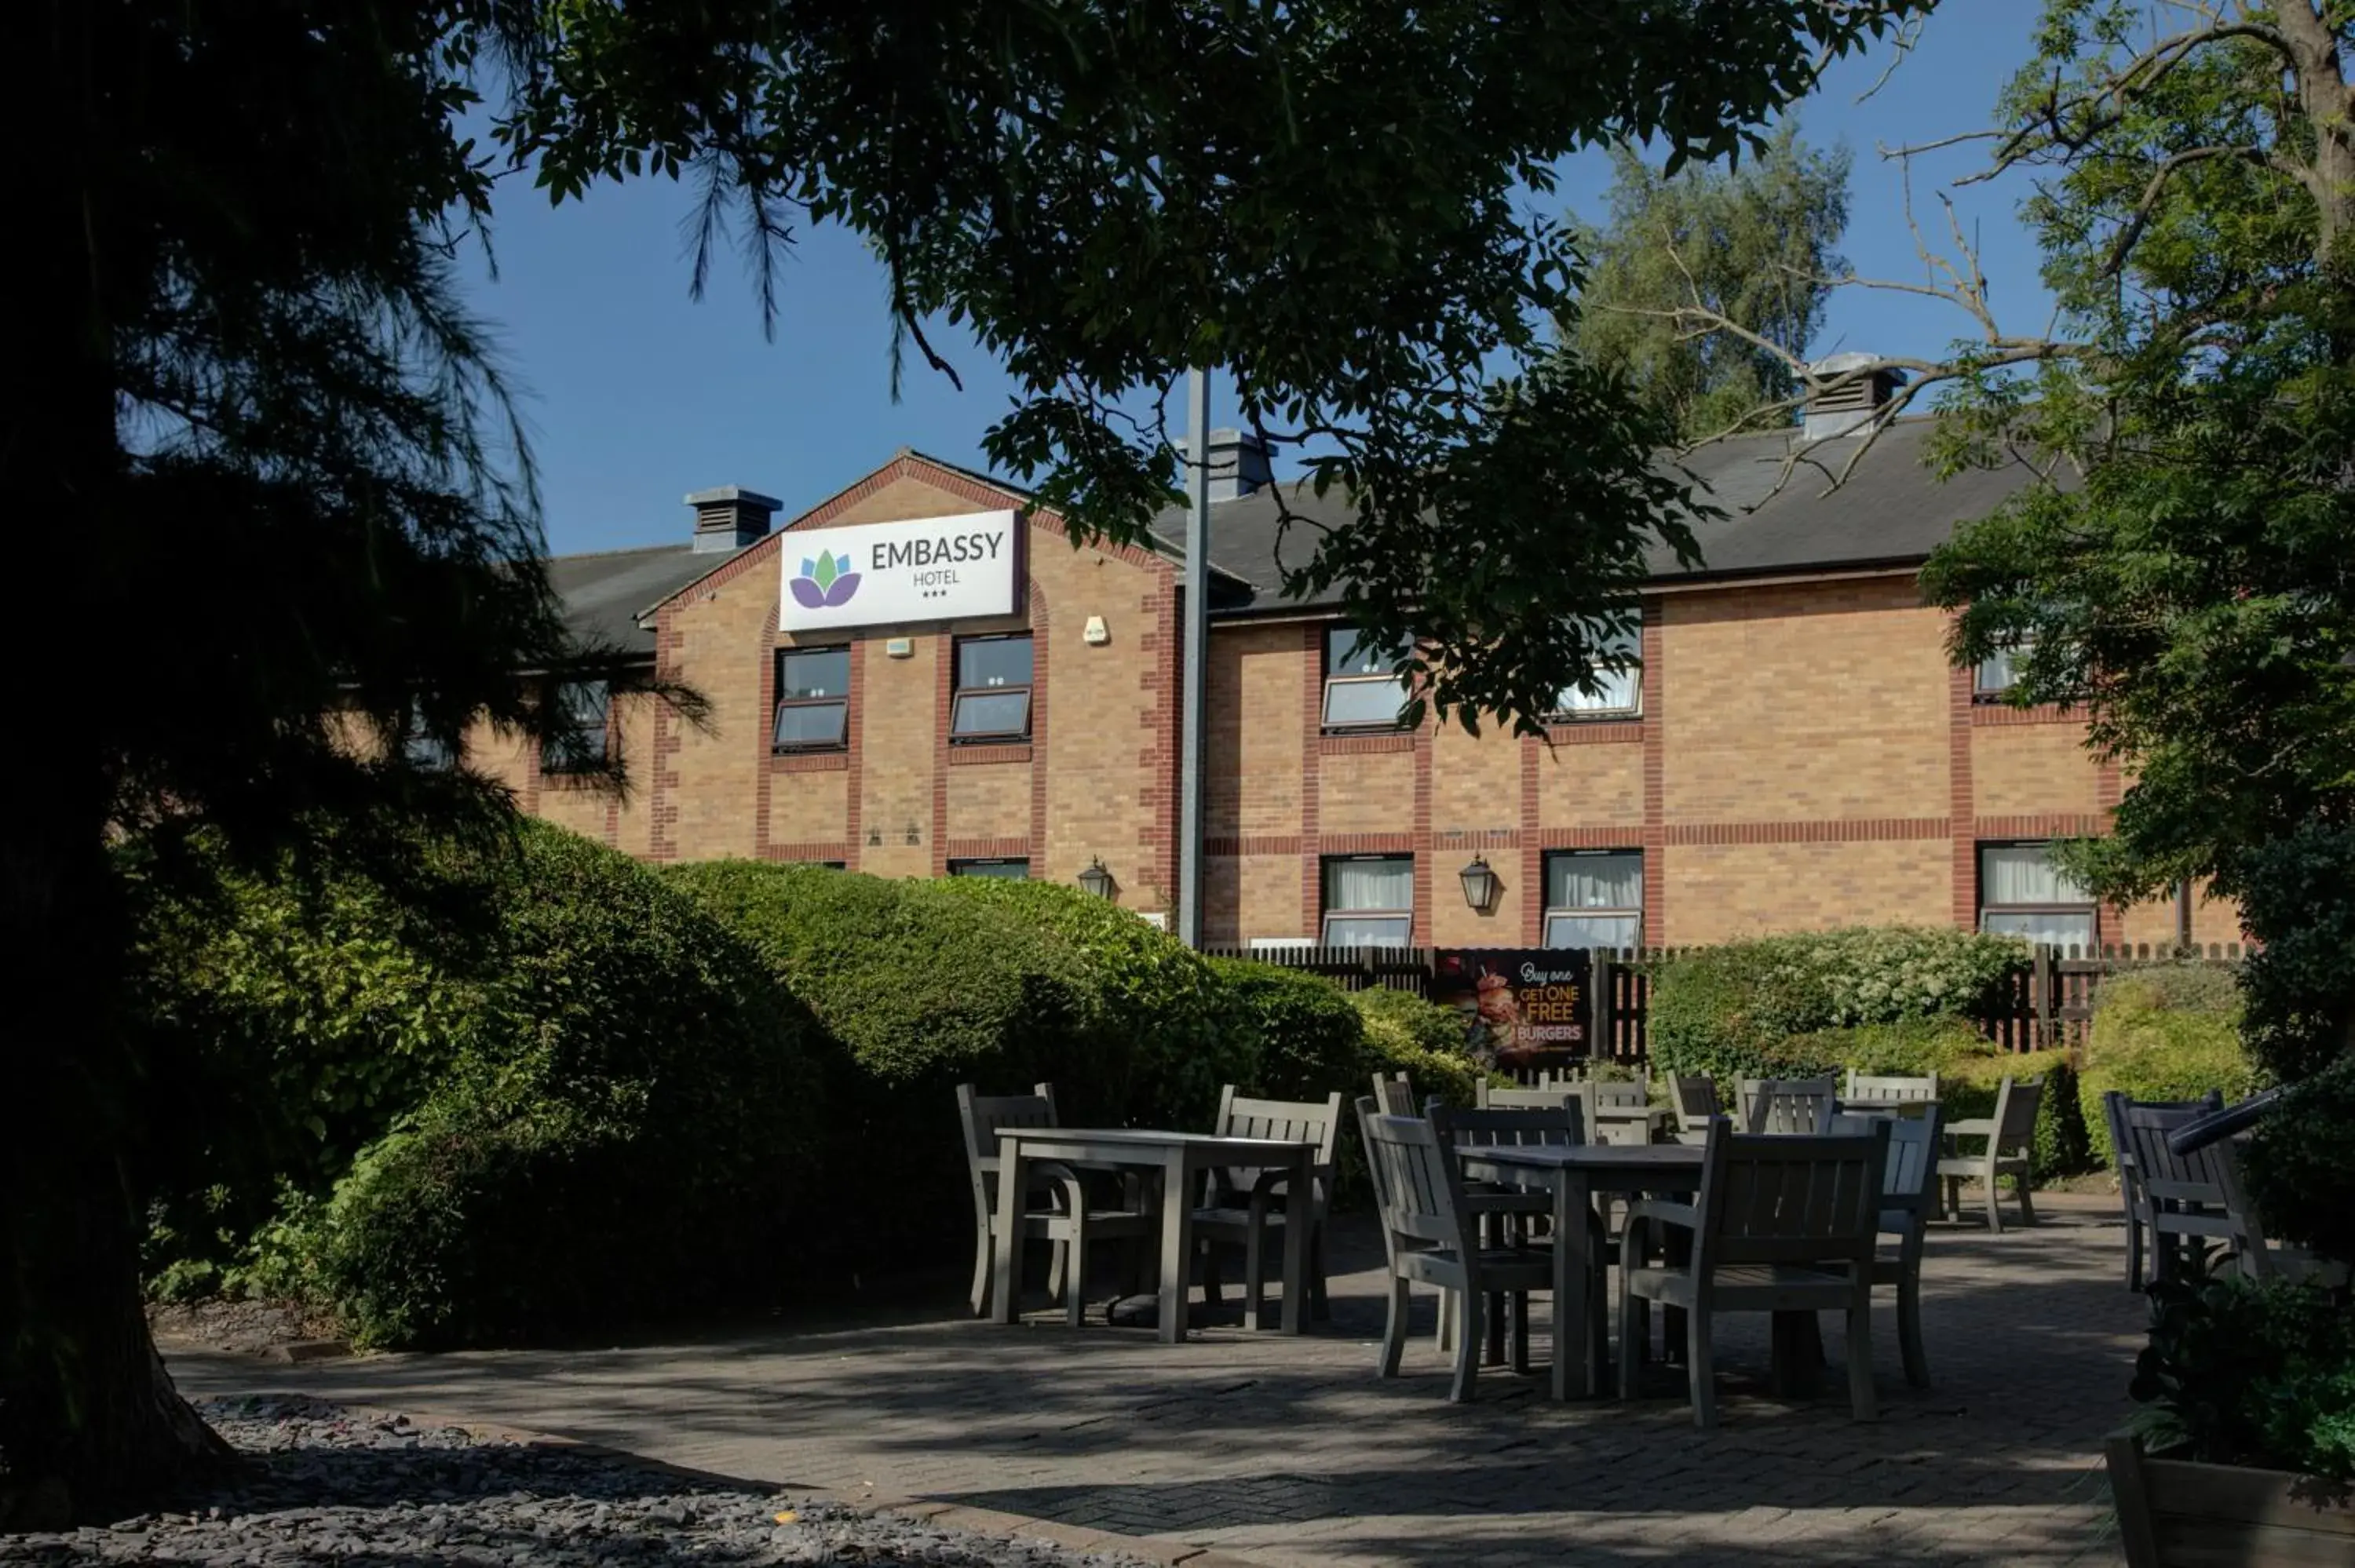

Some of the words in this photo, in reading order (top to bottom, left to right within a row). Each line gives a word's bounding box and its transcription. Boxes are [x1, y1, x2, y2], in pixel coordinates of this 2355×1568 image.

[871, 531, 1004, 571] EMBASSY
[913, 569, 961, 588] HOTEL
[1519, 961, 1548, 986] Buy
[1550, 970, 1573, 983] one
[1519, 988, 1544, 1002] GET
[1546, 986, 1580, 1001] ONE
[1527, 1002, 1574, 1021] FREE
[1517, 1025, 1582, 1041] BURGERS
